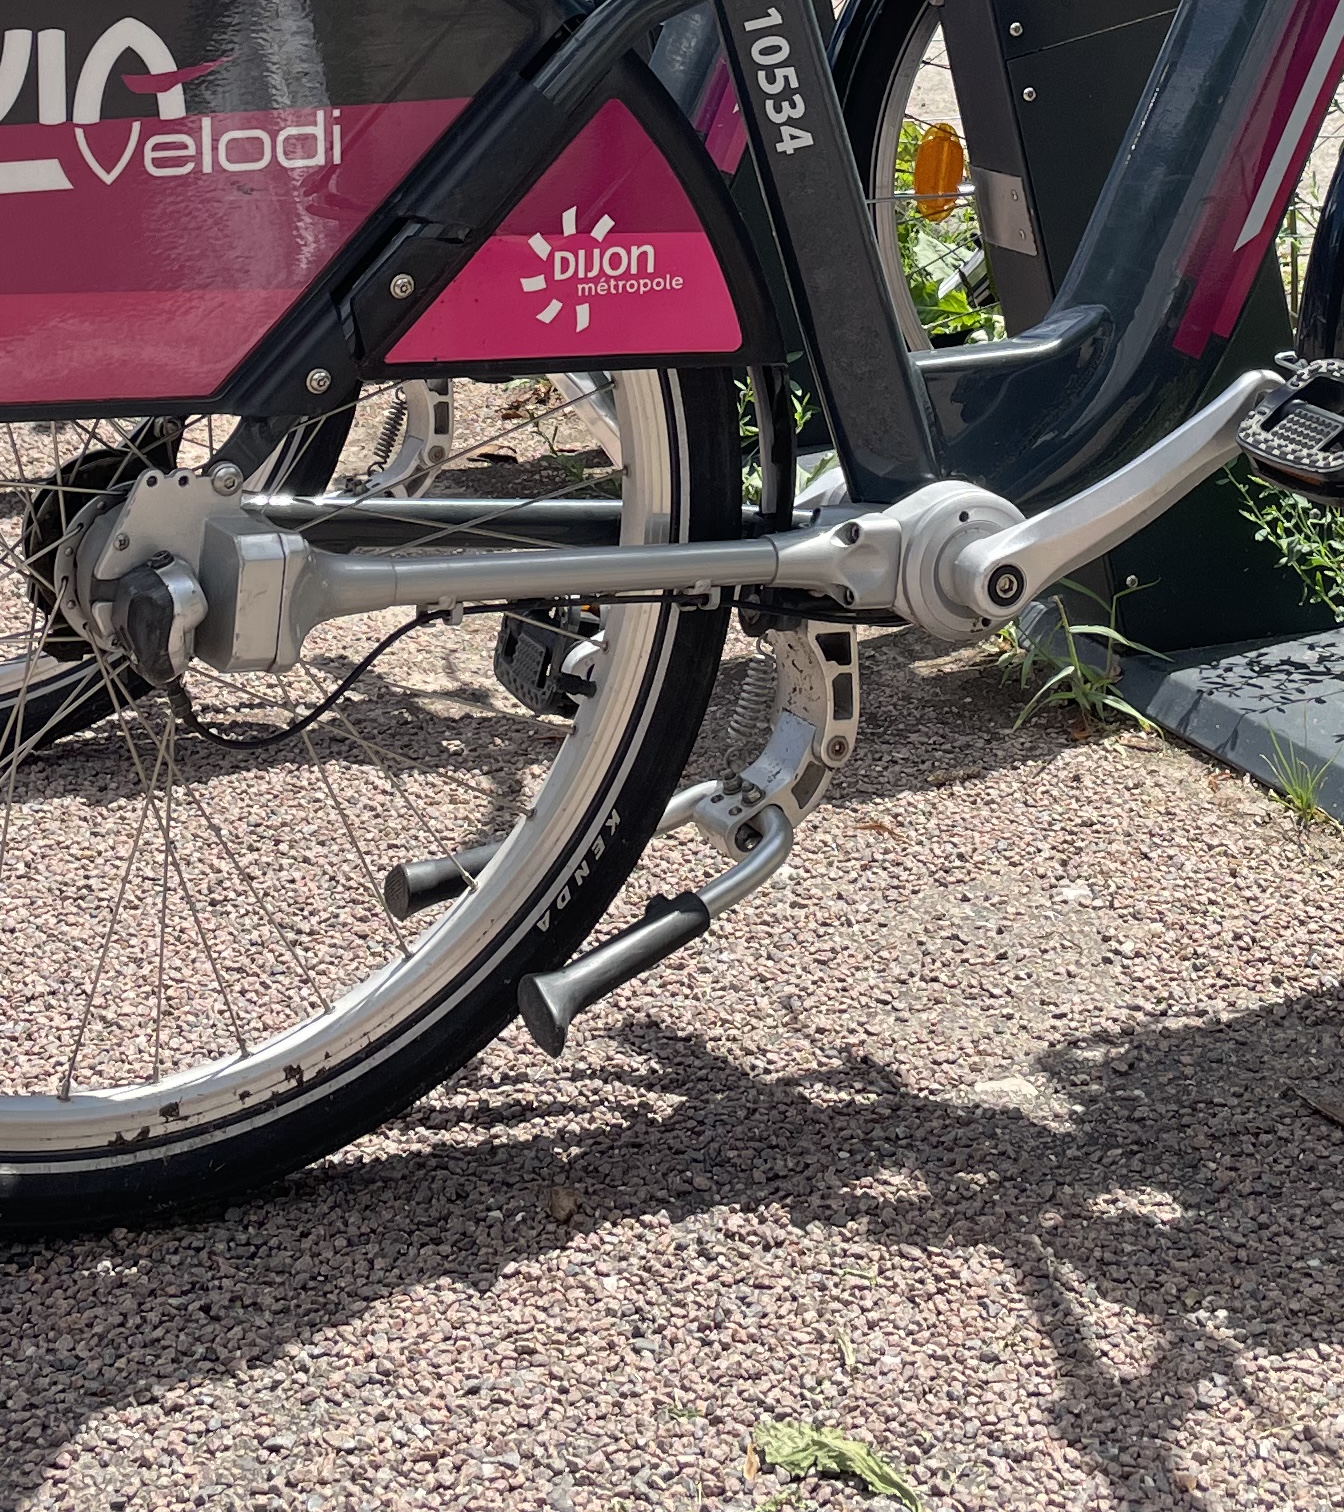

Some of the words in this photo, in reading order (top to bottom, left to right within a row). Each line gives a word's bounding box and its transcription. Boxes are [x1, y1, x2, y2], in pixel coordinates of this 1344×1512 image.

[743, 7, 815, 155] 10534
[576, 273, 684, 297] métropole
[536, 807, 622, 933] KENDA
